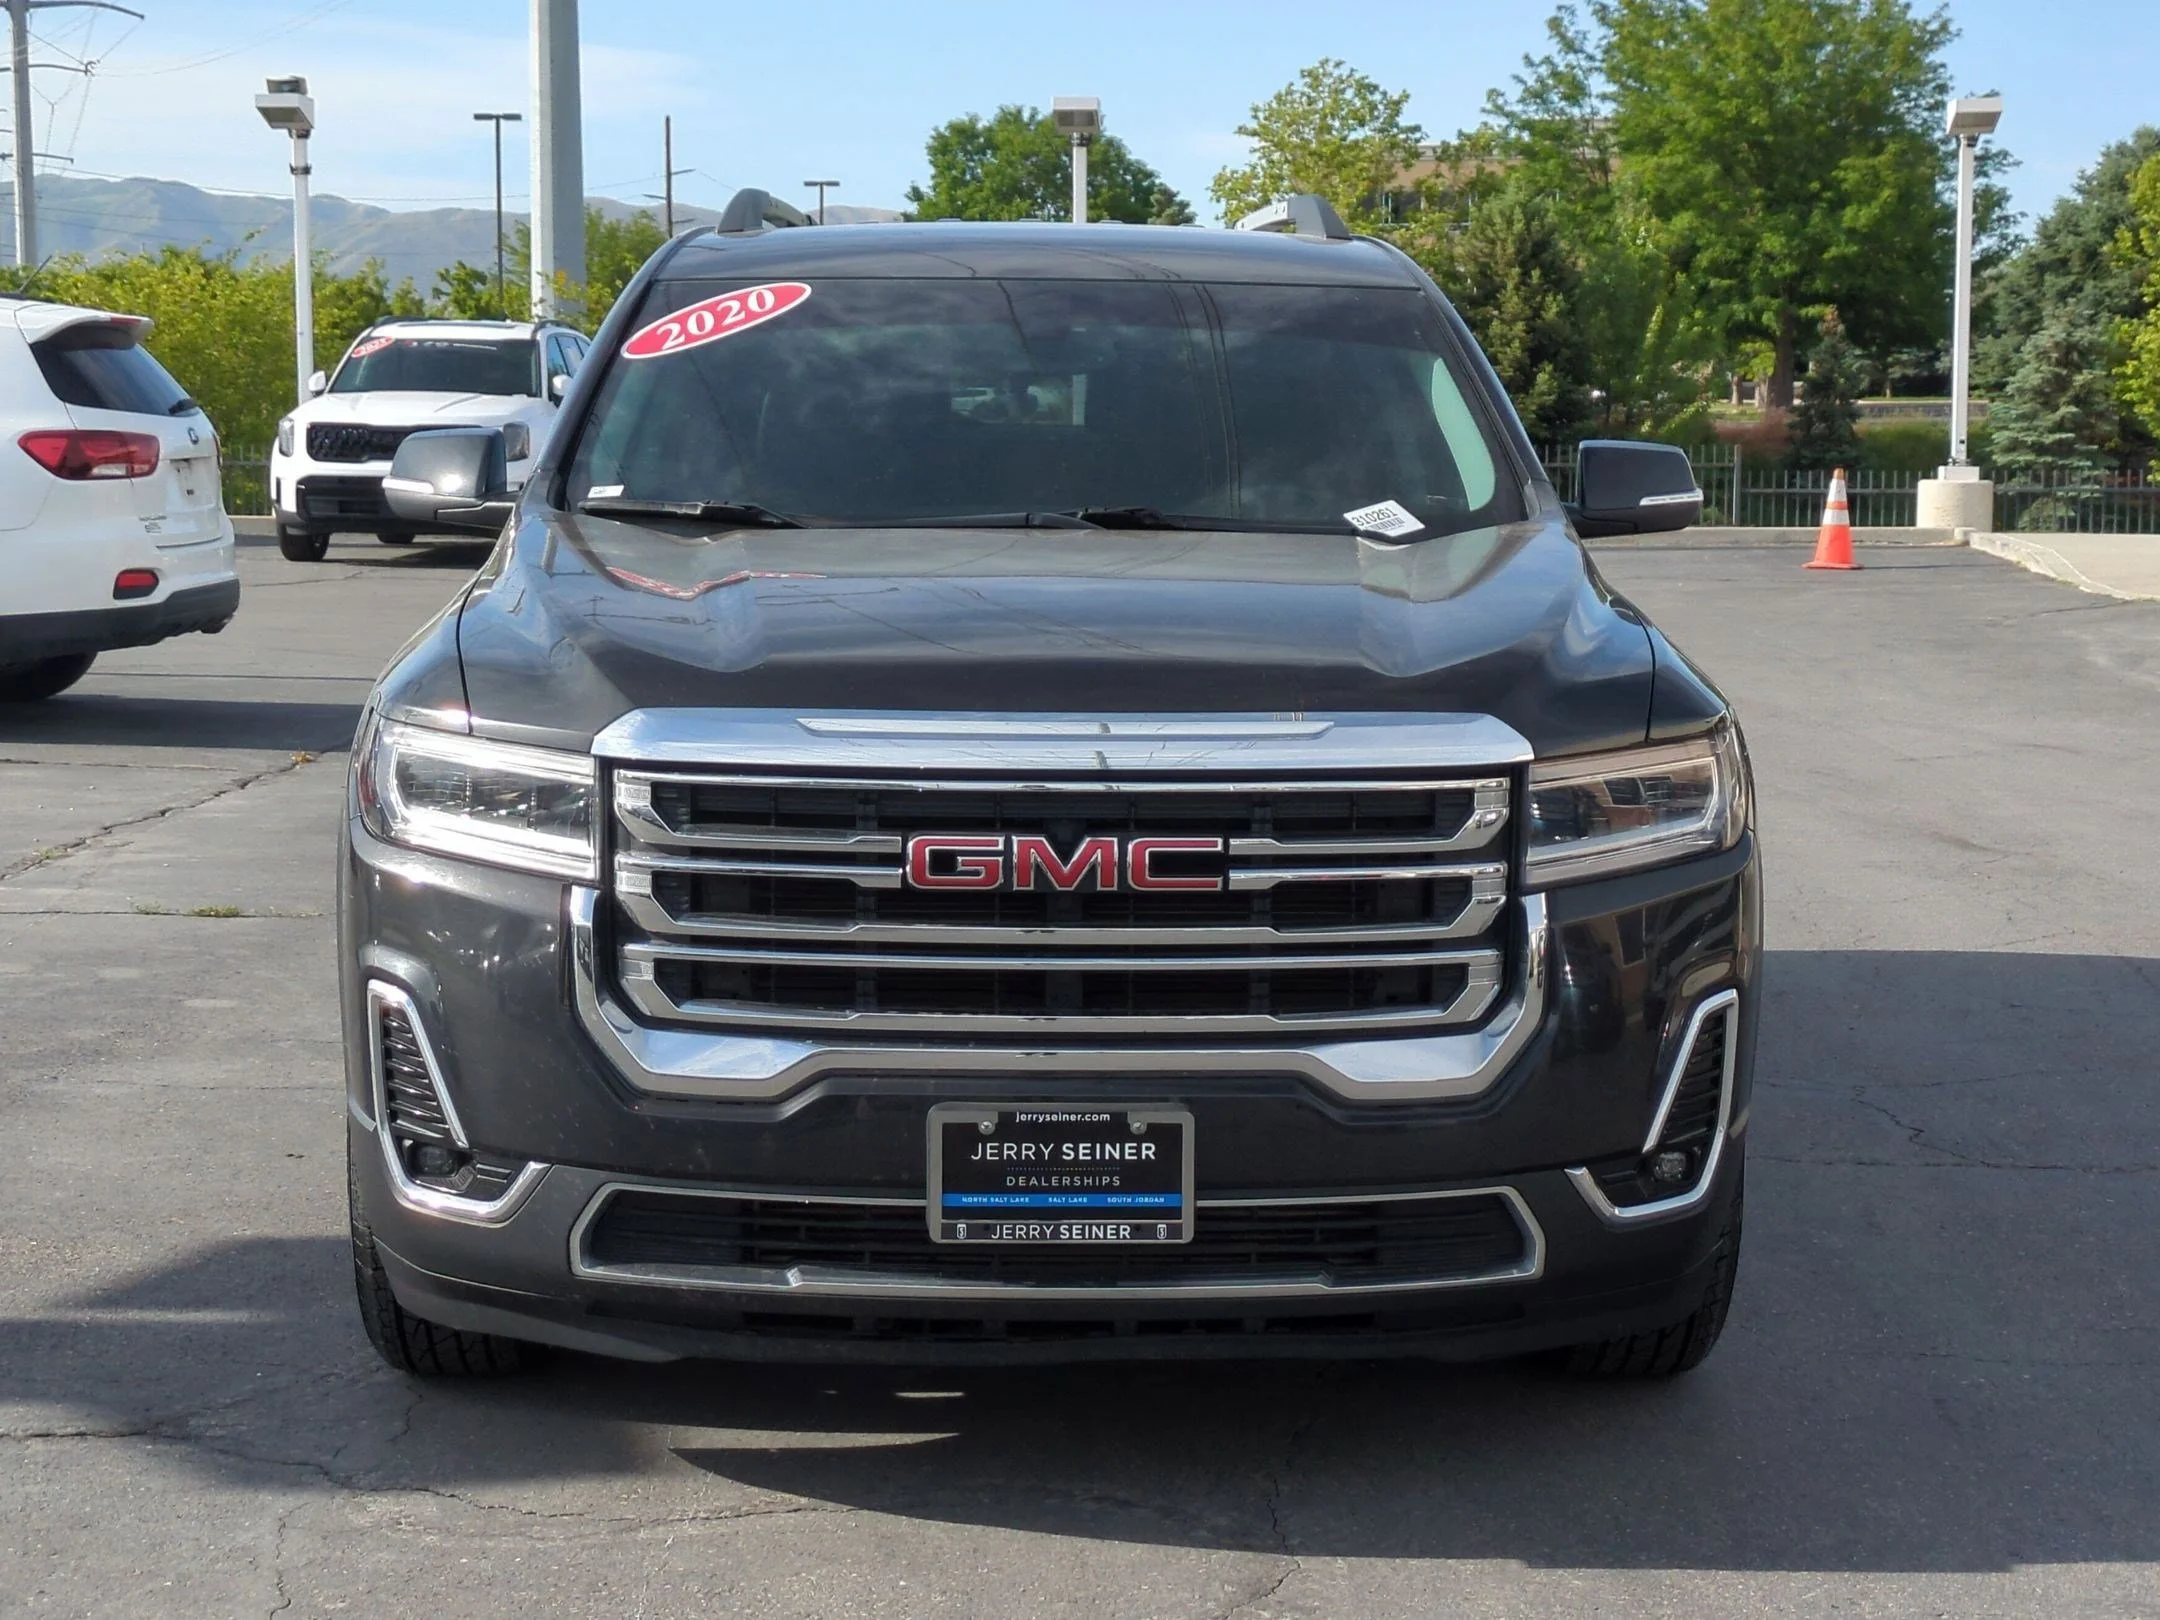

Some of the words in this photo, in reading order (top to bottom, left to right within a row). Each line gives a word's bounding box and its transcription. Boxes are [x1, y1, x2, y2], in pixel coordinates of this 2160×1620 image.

[657, 289, 775, 350] 2020
[1352, 507, 1398, 527] 310261
[907, 835, 1224, 891] GMC
[1015, 1111, 1110, 1123] jerryseiner.com
[971, 1142, 1055, 1161] JERRY
[1061, 1142, 1157, 1161] SEINER
[1006, 1175, 1121, 1187] DEALERSHIPS
[961, 1196, 988, 1204] NORTH
[990, 1196, 1008, 1204] SALT
[1009, 1196, 1030, 1204] LAKE
[1047, 1196, 1066, 1204] SALT
[1068, 1196, 1088, 1204] LAKE
[1107, 1196, 1132, 1204] SOUTH
[1134, 1196, 1165, 1204] JORDAN
[991, 1223, 1054, 1240] JERRY
[1059, 1223, 1131, 1240] SEINER
